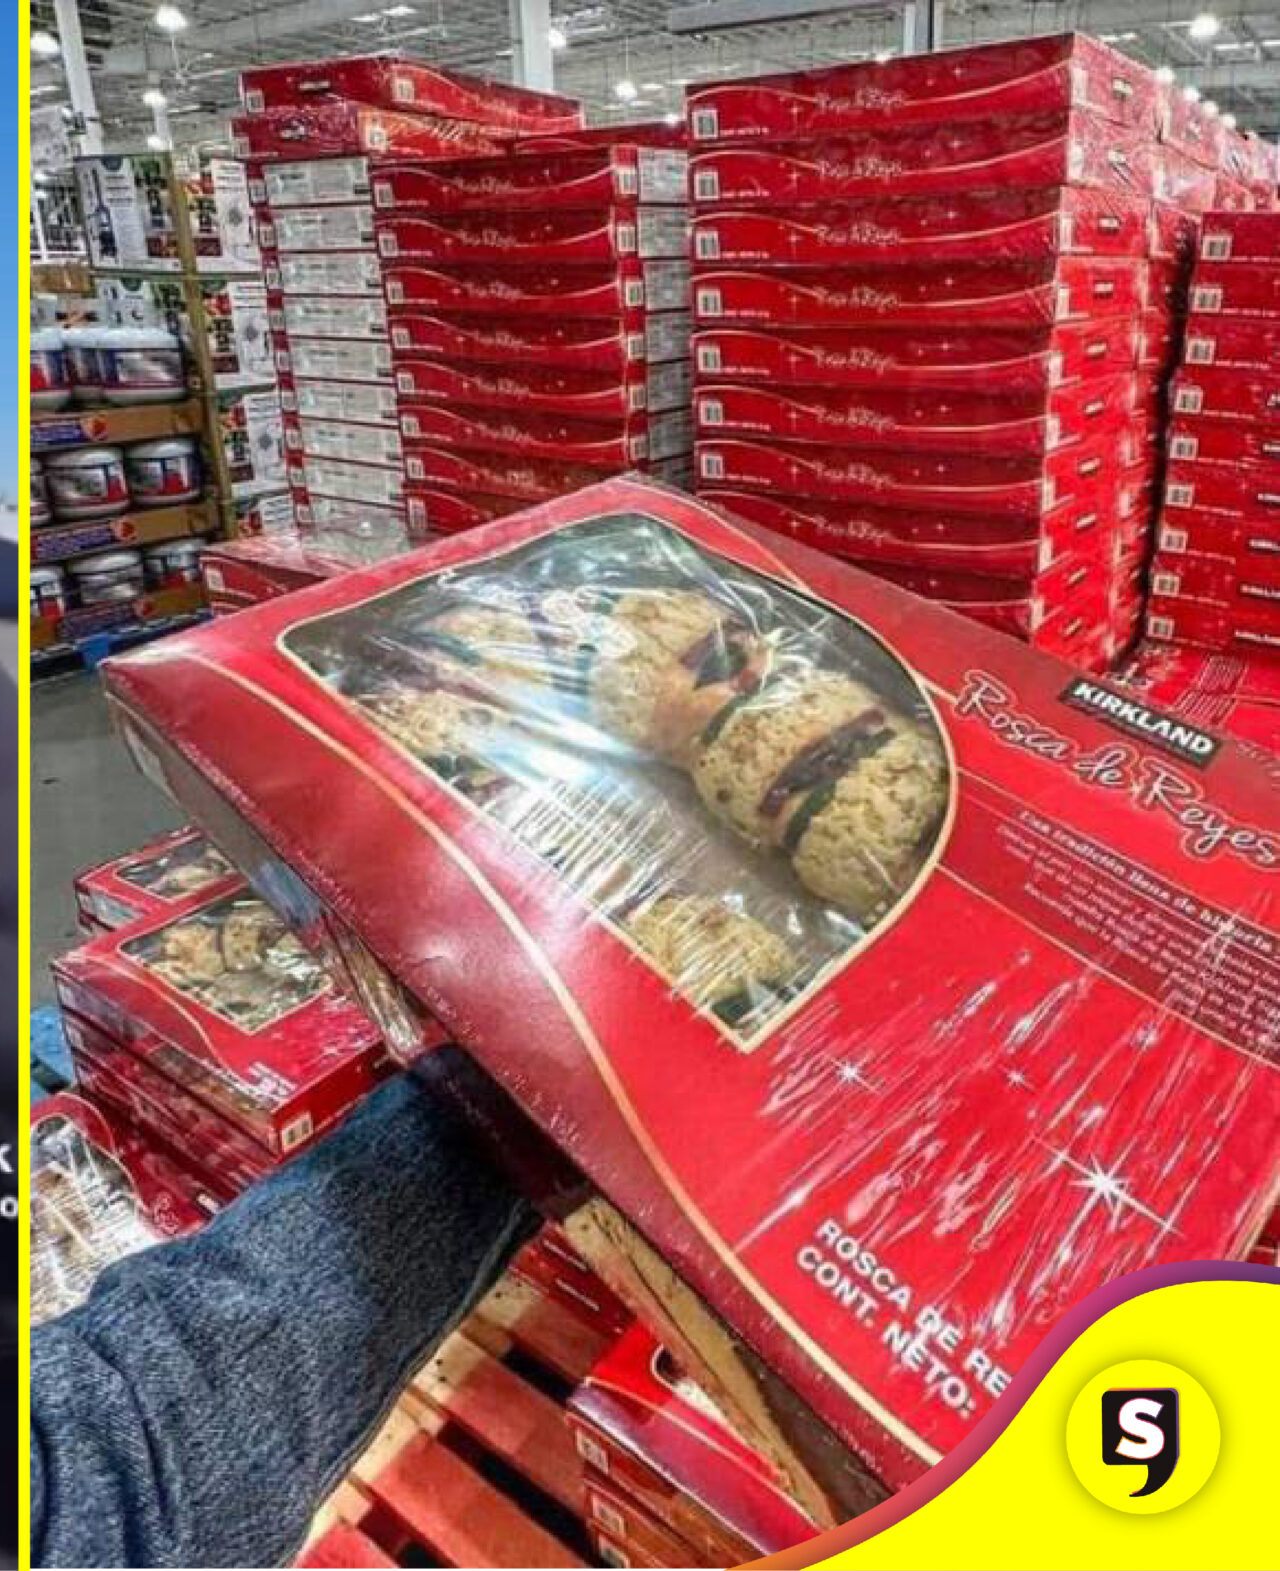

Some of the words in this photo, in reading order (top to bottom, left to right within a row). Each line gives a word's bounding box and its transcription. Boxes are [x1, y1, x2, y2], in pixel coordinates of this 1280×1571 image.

[956, 674, 1071, 760] Rosca
[1073, 746, 1128, 787] de
[1141, 764, 1277, 865] Reyes
[1072, 682, 1215, 756] KIRKLAND
[796, 1244, 879, 1328] CONT.
[880, 1319, 977, 1420] NETO:
[815, 1218, 913, 1313] ROSCA
[914, 1304, 964, 1355] DE
